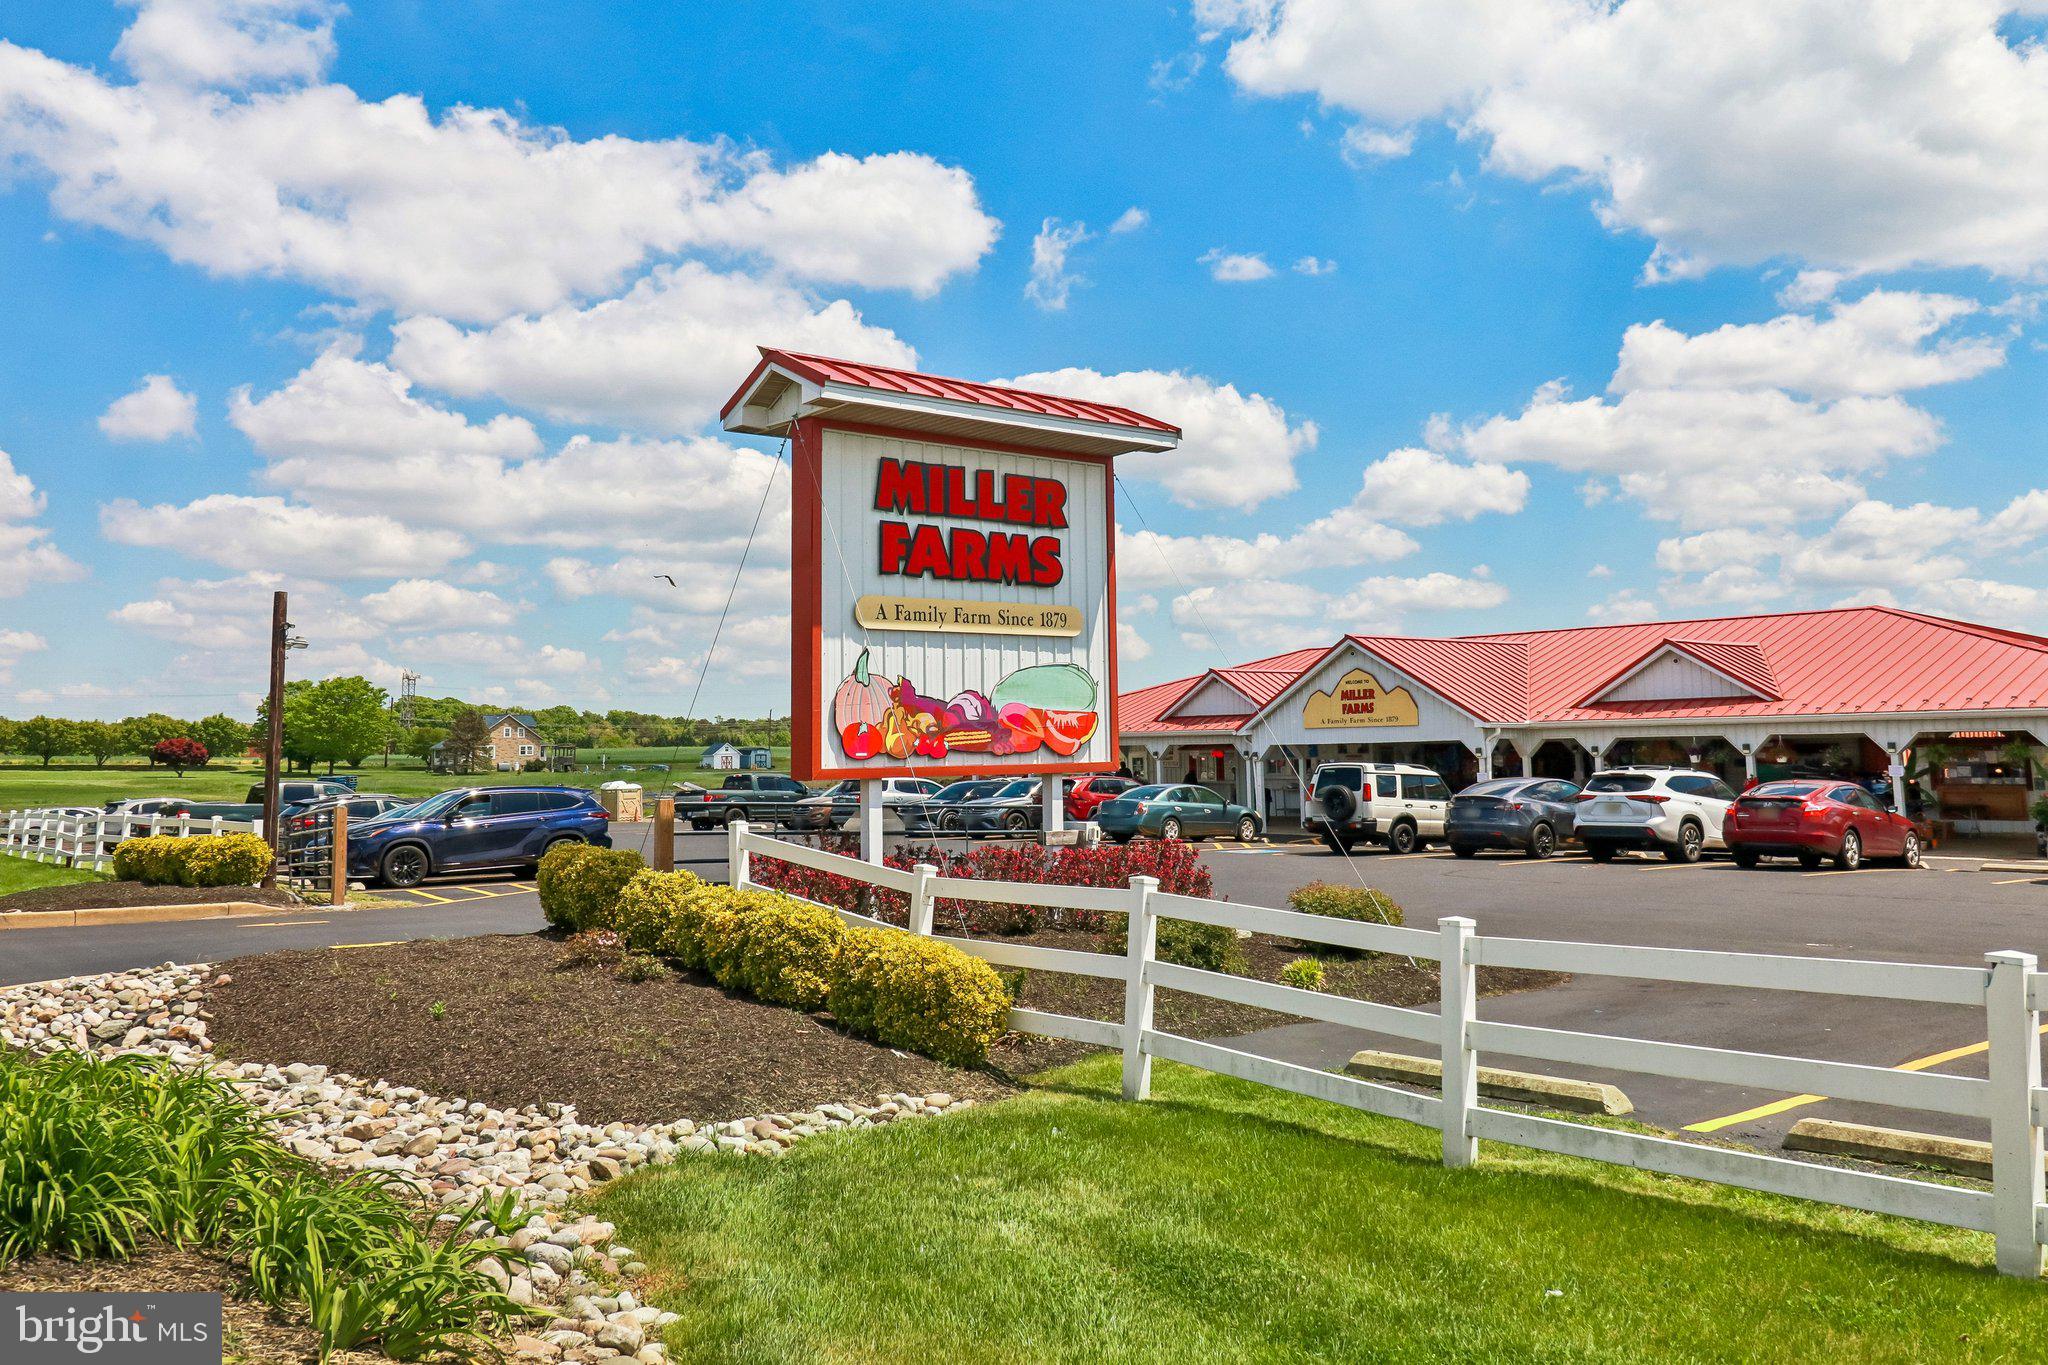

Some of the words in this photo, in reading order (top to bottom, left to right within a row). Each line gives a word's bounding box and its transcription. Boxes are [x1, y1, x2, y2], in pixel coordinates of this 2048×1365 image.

[874, 456, 1069, 528] MILLER
[879, 520, 1064, 587] FARMS
[875, 603, 888, 620] A
[894, 604, 947, 628] Family
[953, 607, 991, 625] Farm
[997, 609, 1034, 627] Since
[1040, 612, 1067, 628] 1879
[1340, 688, 1375, 701] MILLER
[1342, 702, 1374, 714] FARMS
[1327, 717, 1347, 726] Family
